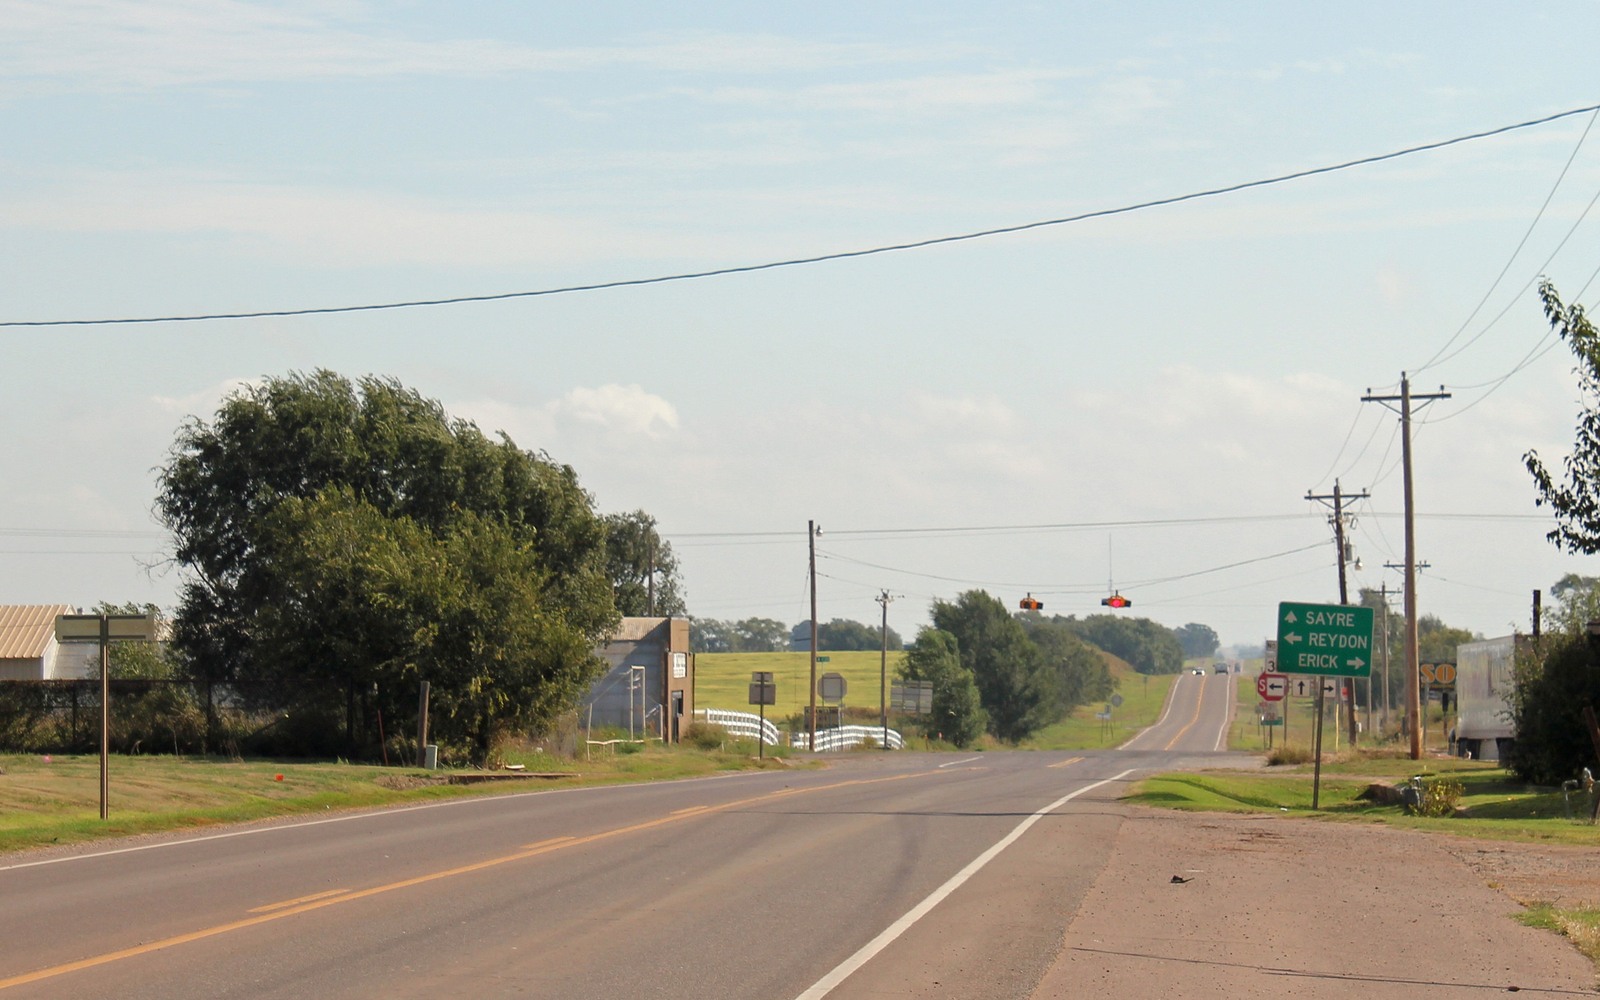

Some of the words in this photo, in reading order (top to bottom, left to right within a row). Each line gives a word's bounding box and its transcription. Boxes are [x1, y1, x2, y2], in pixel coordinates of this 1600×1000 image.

[1305, 611, 1355, 627] SAYRE
[1308, 632, 1368, 649] REYDON
[1298, 653, 1338, 669] ERICK
